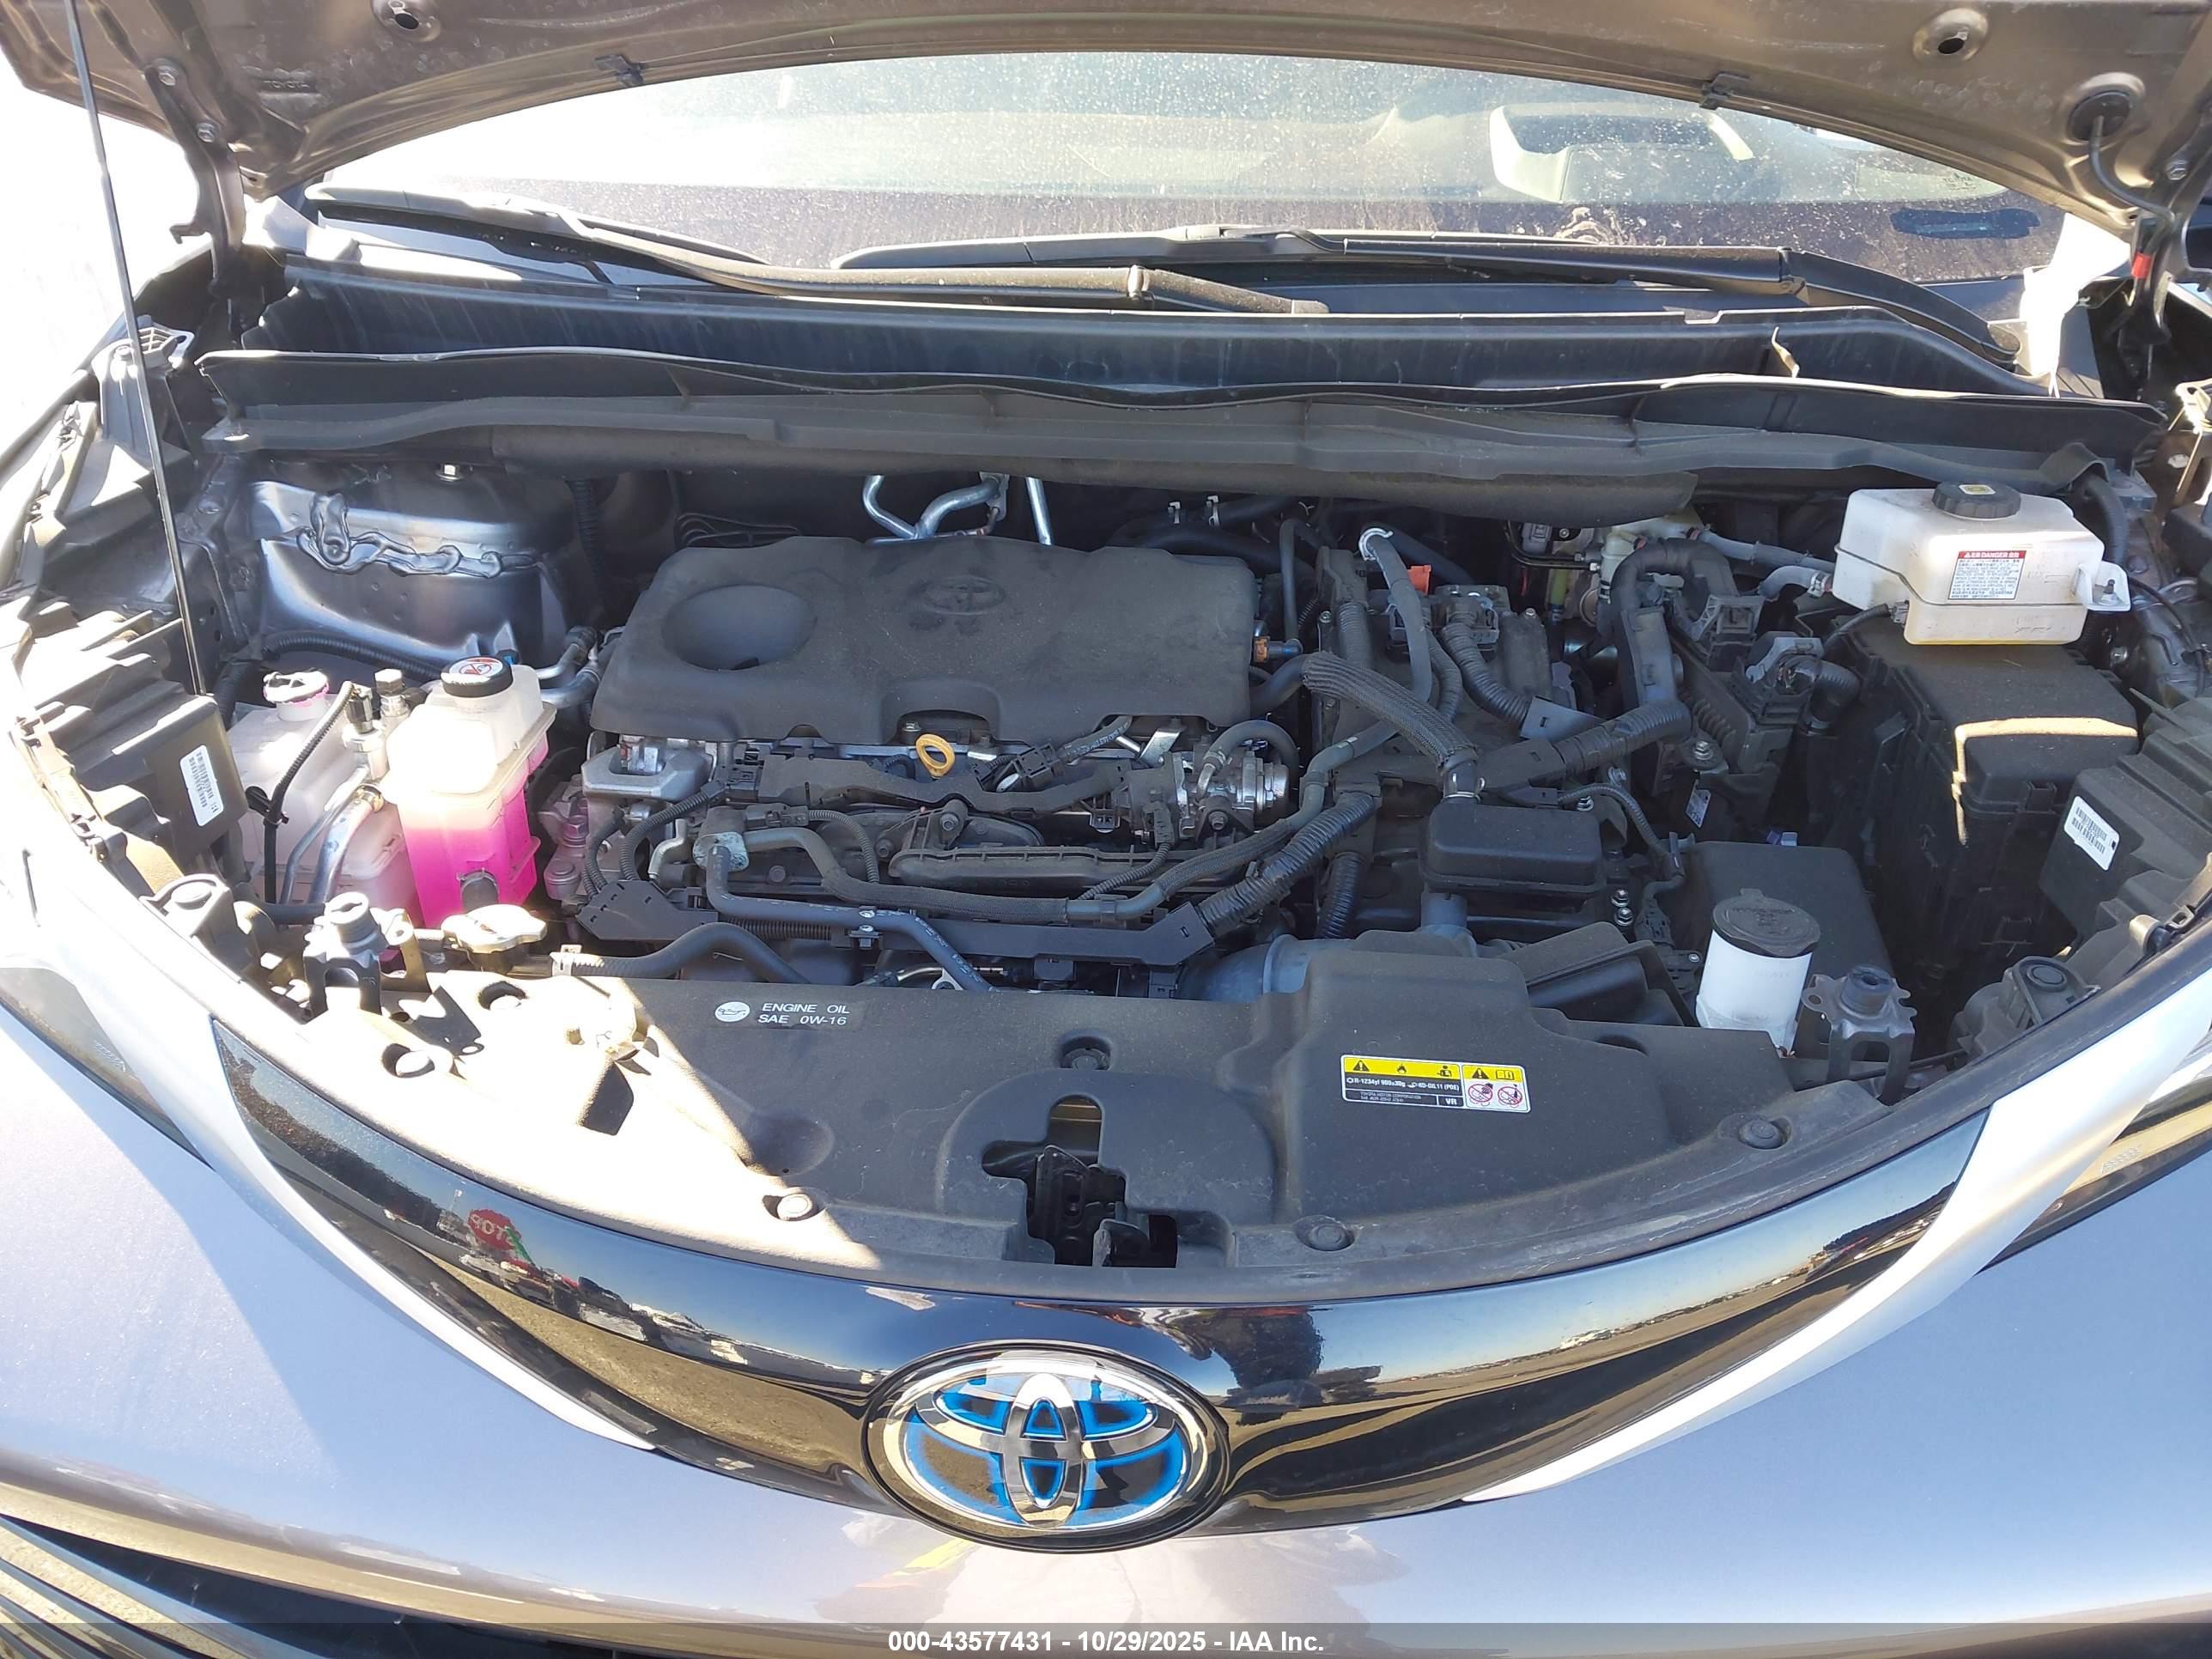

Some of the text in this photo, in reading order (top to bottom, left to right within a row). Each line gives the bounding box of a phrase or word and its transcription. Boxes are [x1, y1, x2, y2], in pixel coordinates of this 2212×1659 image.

[762, 1003, 850, 1014] ENGINE OIL
[757, 1014, 847, 1025] SAE 0W-16
